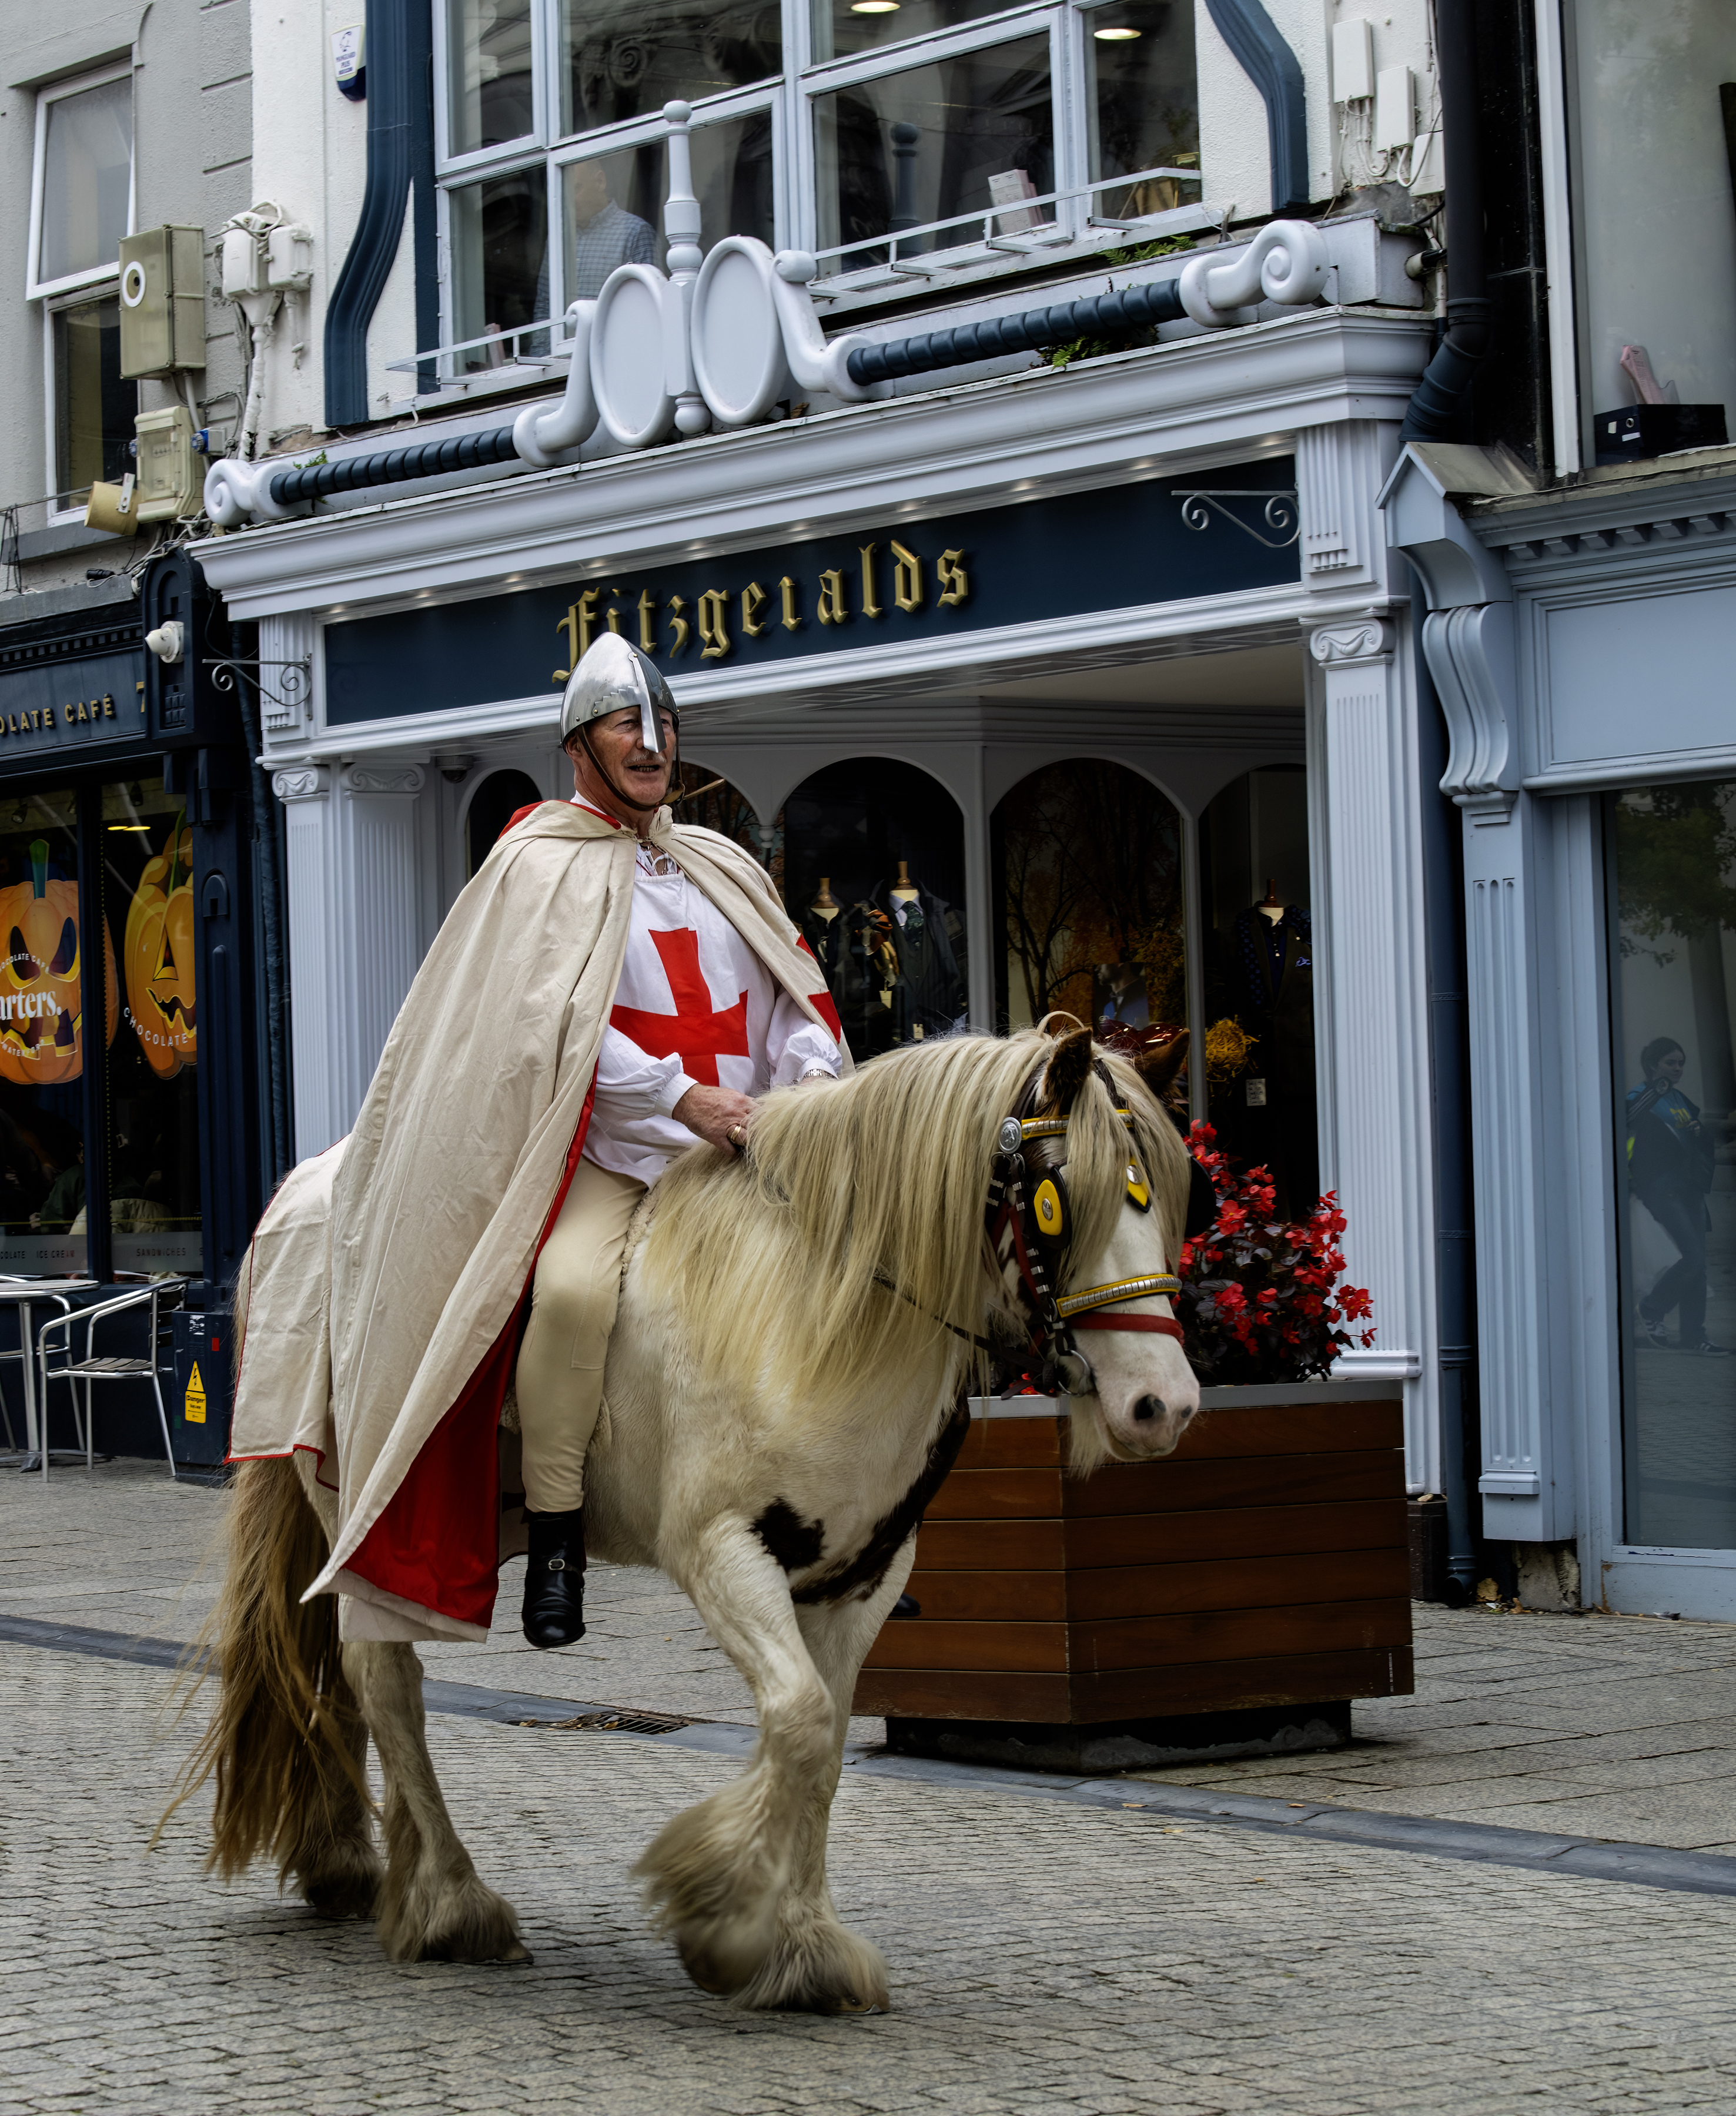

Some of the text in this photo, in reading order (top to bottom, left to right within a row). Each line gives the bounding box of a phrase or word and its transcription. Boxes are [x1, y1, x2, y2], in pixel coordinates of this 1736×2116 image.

[64, 693, 114, 722] CAFÉ
[123, 1007, 188, 1047] CHOCOLATE
[136, 1247, 186, 1257] SANDWICHES
